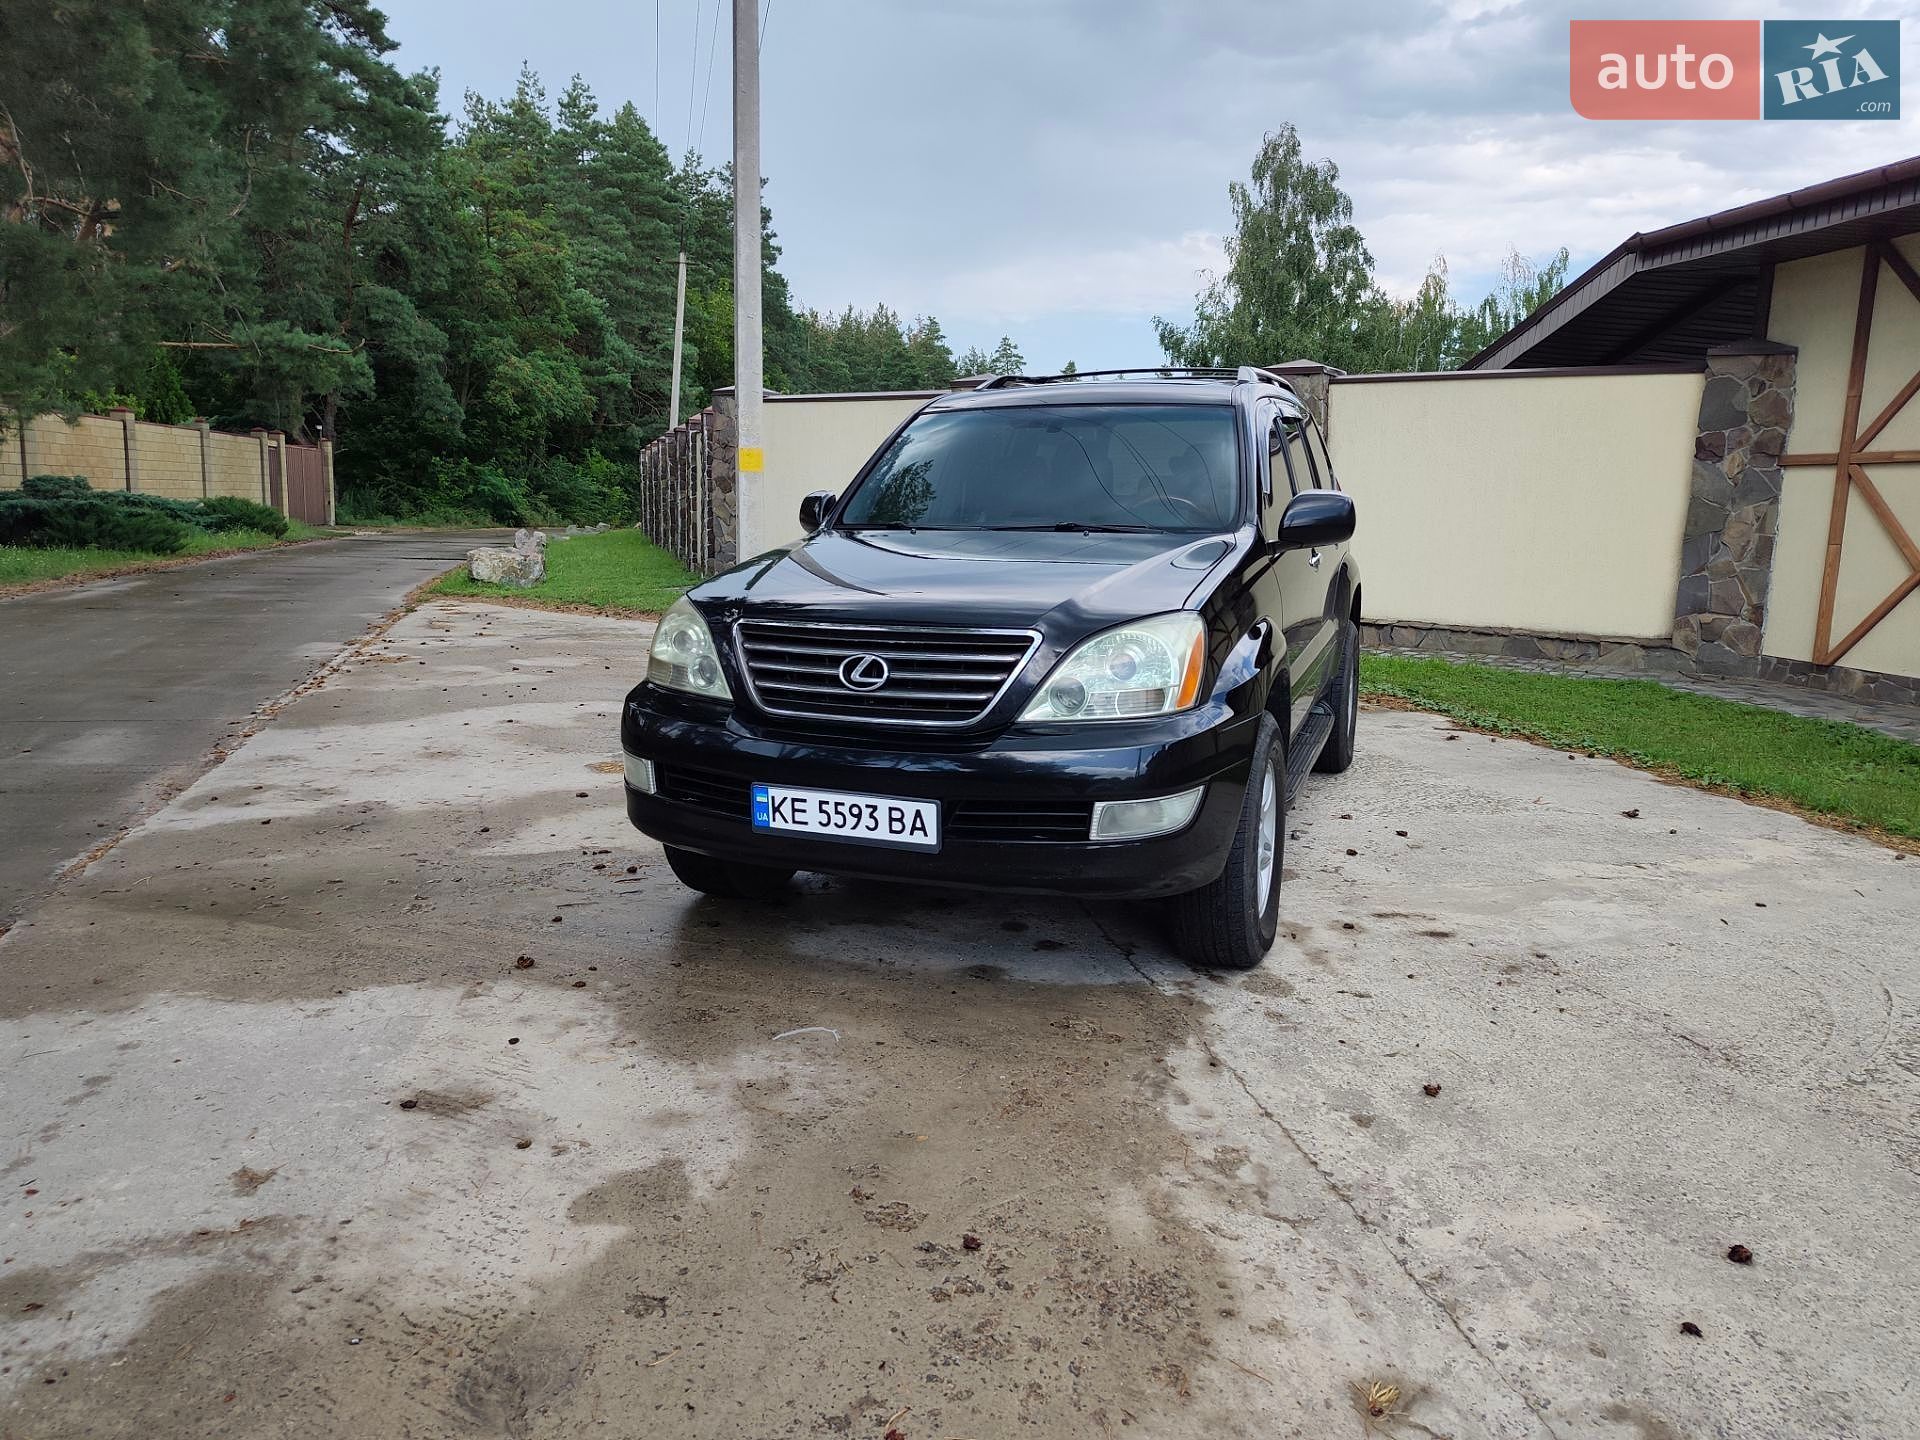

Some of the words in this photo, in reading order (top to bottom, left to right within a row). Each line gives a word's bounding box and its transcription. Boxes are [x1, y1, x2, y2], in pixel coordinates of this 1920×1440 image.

[757, 812, 768, 822] UA
[771, 796, 808, 825] KE
[818, 800, 879, 831] 5593
[888, 806, 928, 837] BA
